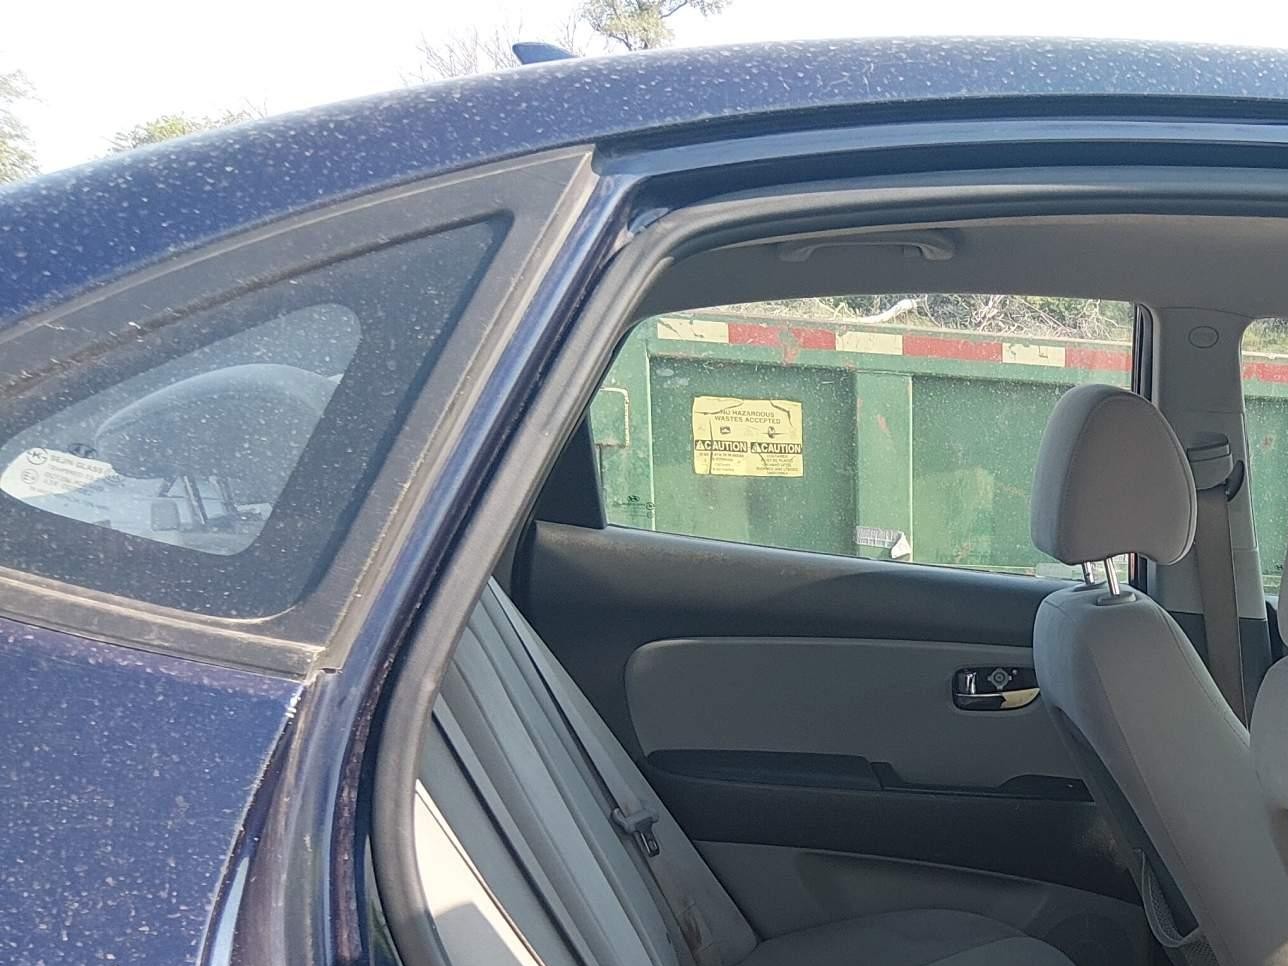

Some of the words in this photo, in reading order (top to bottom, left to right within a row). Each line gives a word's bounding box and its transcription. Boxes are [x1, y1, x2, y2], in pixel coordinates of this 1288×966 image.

[732, 410, 775, 418] HAZARDOUS
[714, 415, 744, 423] WASTES
[744, 417, 781, 425] ACCEPTED
[704, 441, 747, 452] CAUTION
[760, 443, 801, 454] CAUTION
